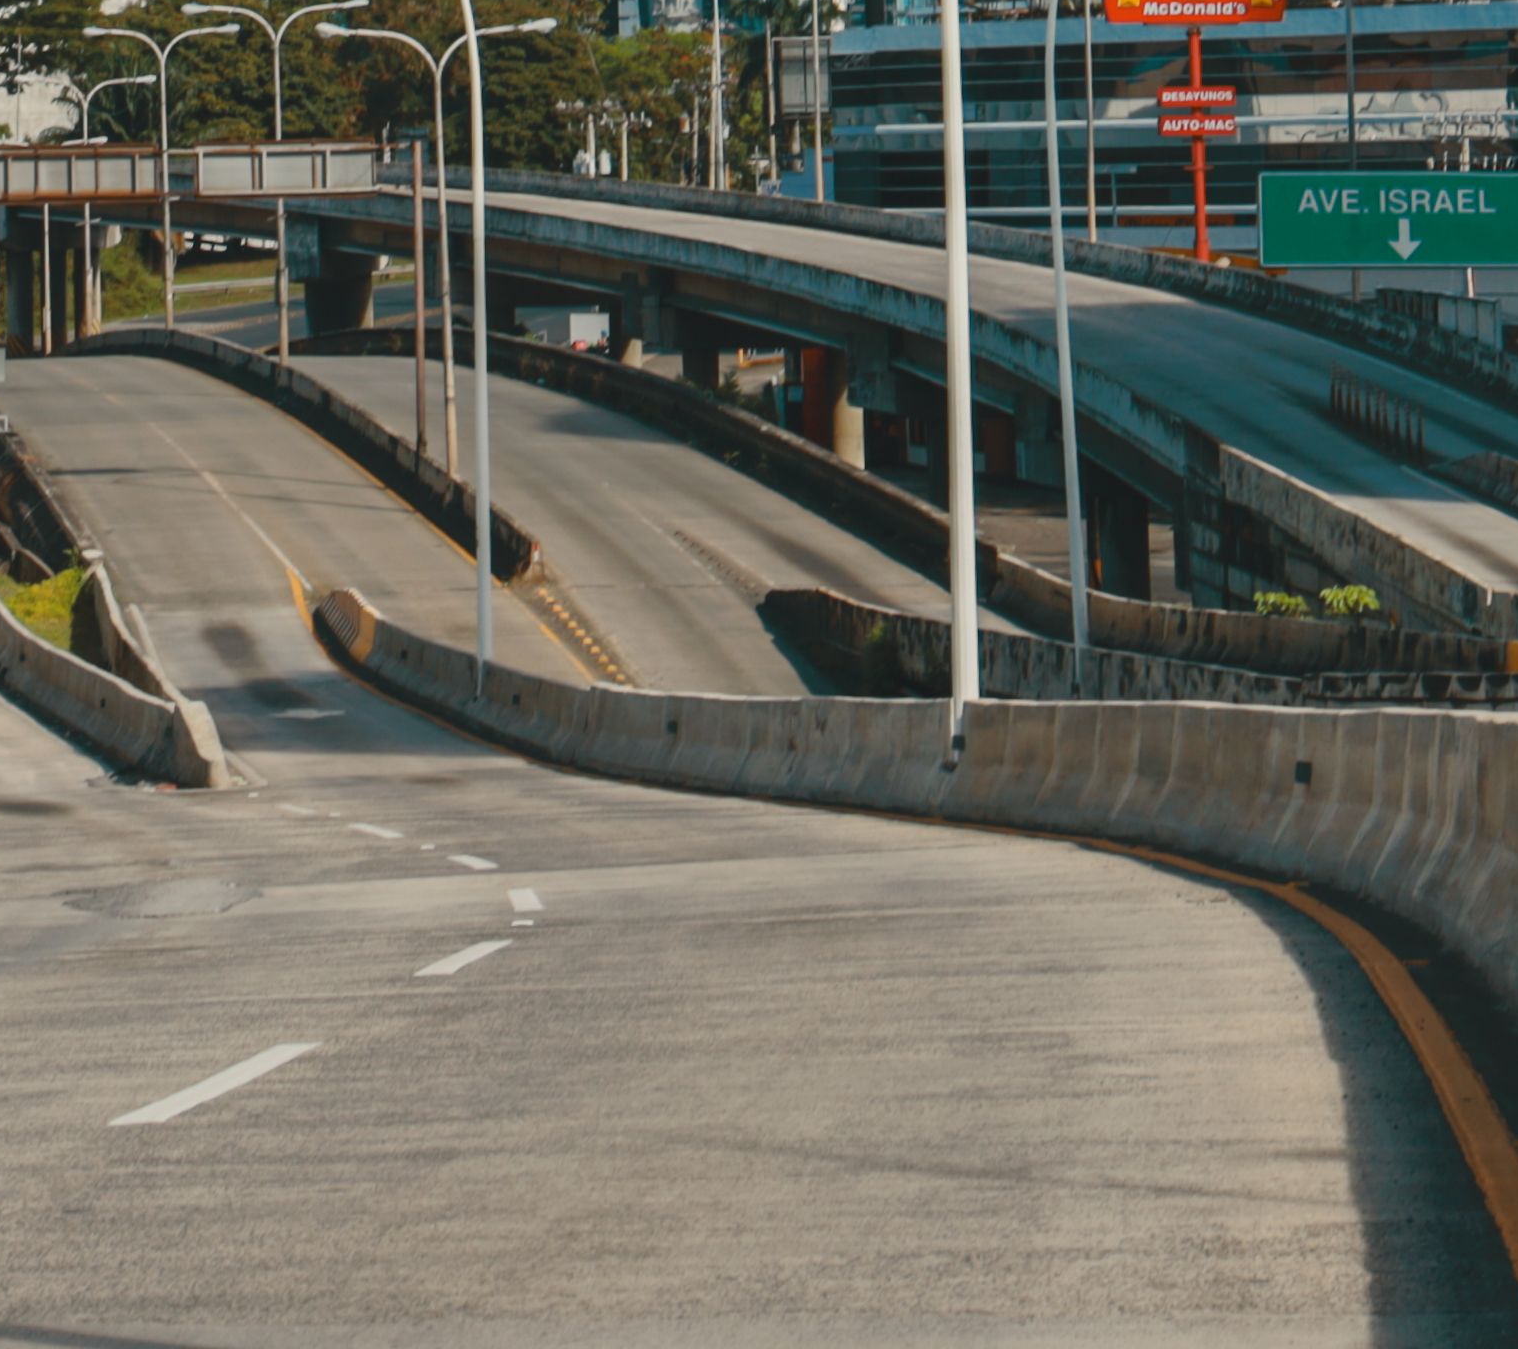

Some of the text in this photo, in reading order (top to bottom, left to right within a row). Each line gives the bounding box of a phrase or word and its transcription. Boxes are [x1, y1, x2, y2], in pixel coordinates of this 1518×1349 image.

[1143, 1, 1246, 16] McDonald's
[1161, 90, 1233, 102] DESAYUNOS
[1298, 188, 1495, 214] AVE. ISRAEL
